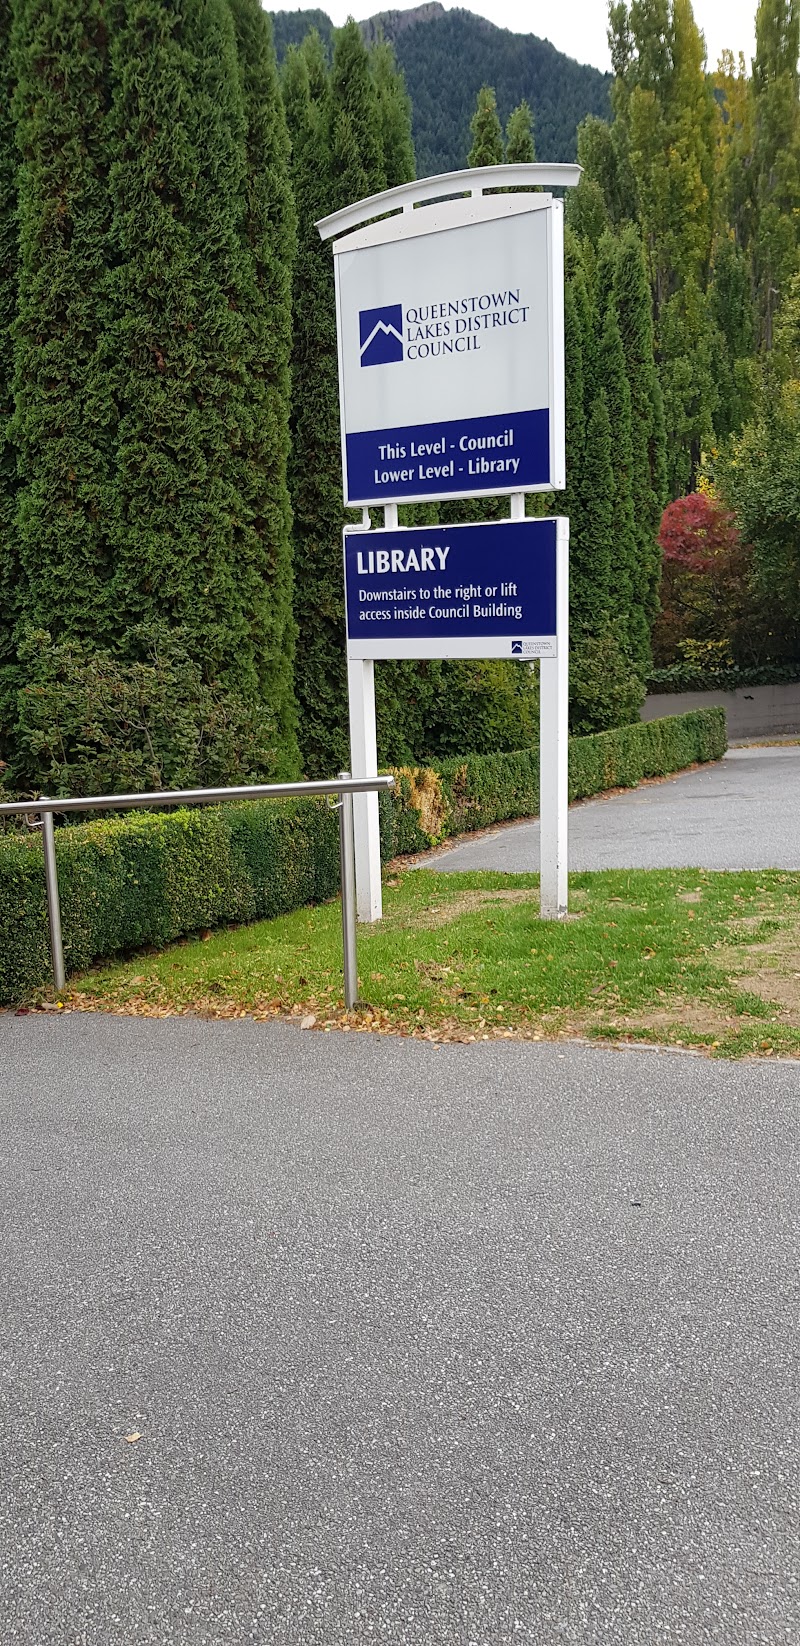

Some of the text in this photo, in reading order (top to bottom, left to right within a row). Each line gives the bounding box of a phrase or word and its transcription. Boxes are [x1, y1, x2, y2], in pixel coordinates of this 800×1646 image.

[406, 289, 520, 324] QUEENSTOWN
[407, 306, 530, 342] LAKES DISTRICT
[407, 335, 481, 360] COUNCIL
[378, 442, 406, 461] This
[410, 437, 446, 457] Level
[459, 429, 514, 451] Council
[374, 468, 415, 484] Lower
[418, 460, 454, 480] Level
[468, 457, 520, 475] Library
[357, 546, 450, 574] LIBRARY
[358, 582, 518, 602] Downstairs to the right or lift
[359, 603, 523, 621] access inside Council Building
